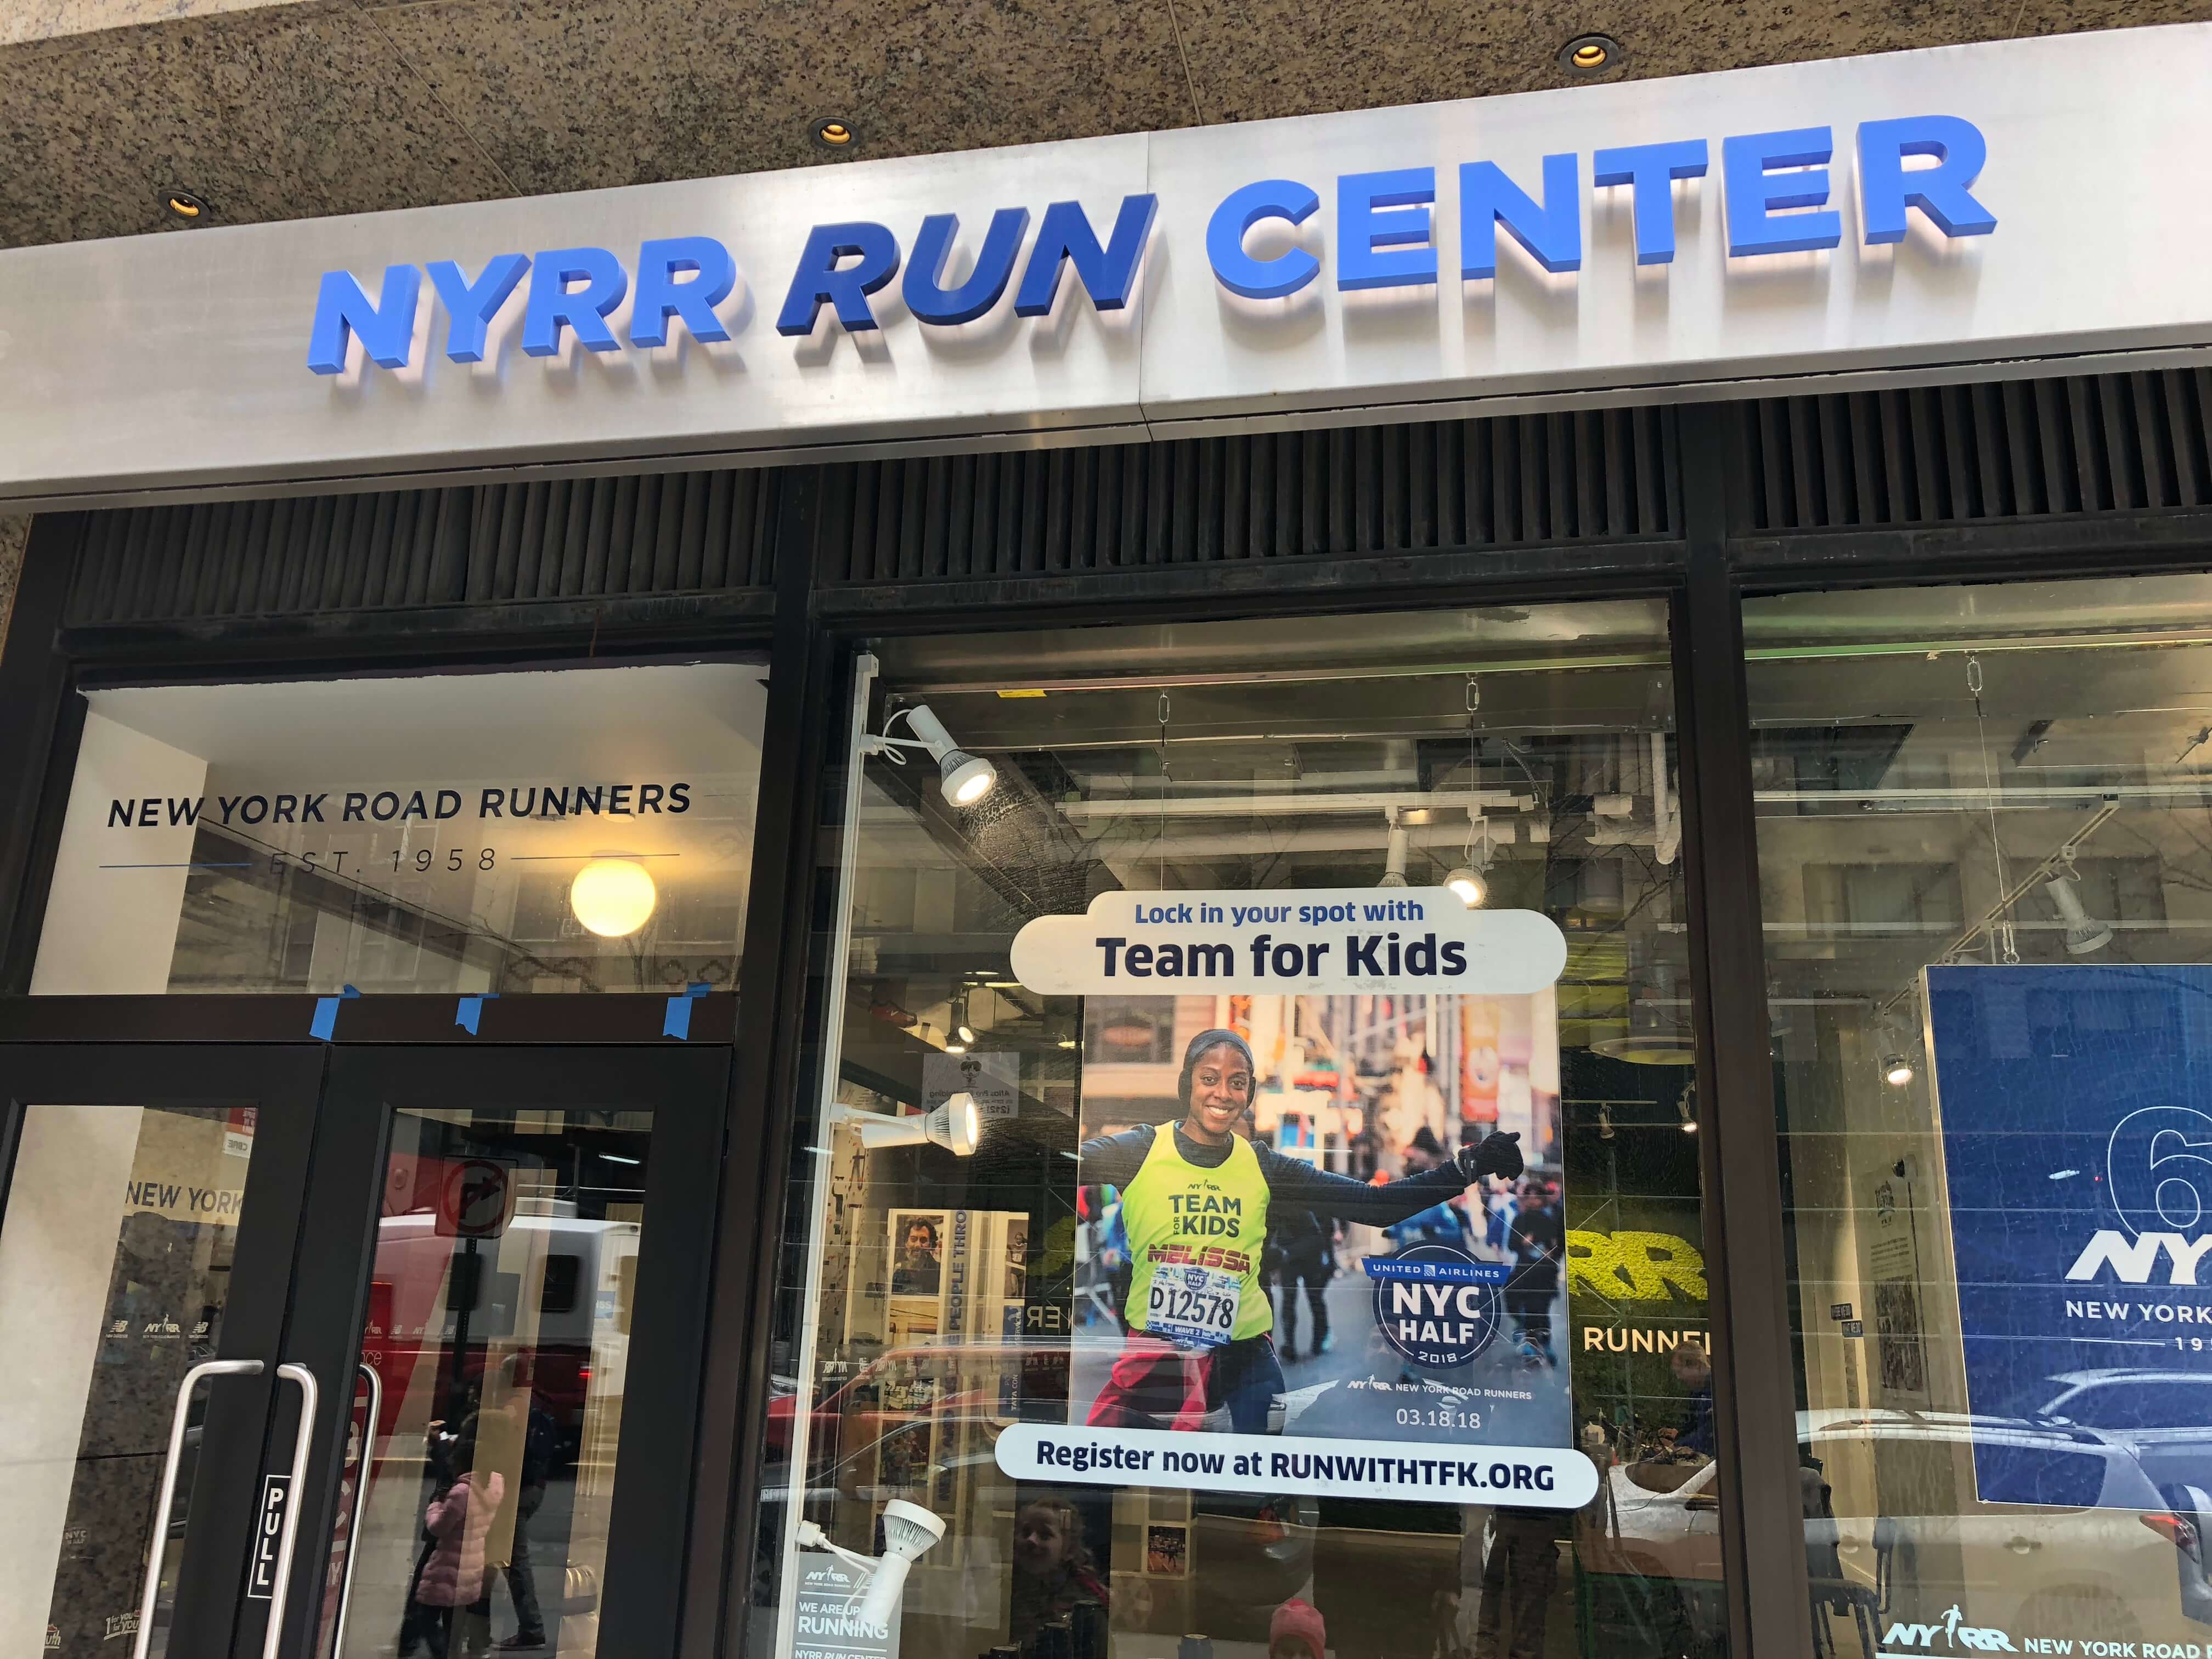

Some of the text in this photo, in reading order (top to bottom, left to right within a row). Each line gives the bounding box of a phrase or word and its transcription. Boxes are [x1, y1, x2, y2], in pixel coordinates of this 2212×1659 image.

[307, 115, 1997, 375] NYRR RUN CENTER
[108, 783, 692, 827] NEW YORK ROAD RUNNERS
[271, 848, 496, 874] EST. 1958
[1136, 900, 1423, 927] Lock in your spot with
[1096, 933, 1467, 978] Team for Kids
[125, 1181, 242, 1214] NEW YORK
[1169, 1194, 1241, 1216] TEAM
[1183, 1215, 1240, 1238] KIDS
[1148, 1244, 1250, 1274] MELISSA
[1373, 1263, 1499, 1278] UNITED AIRLINES
[950, 1262, 964, 1331] PEOPLE
[1392, 1282, 1481, 1319] NYC
[2067, 1300, 2212, 1324] NEW YORK
[1175, 1326, 1194, 1335] WAVE
[1400, 1319, 1475, 1344] HALF
[2175, 1337, 2212, 1351] 19
[1418, 1351, 1457, 1363] 2018
[1347, 1381, 1532, 1400] NYRR NEW YORK ROAD RUNNERS
[1396, 1408, 1481, 1429] 03.18.18
[1037, 1441, 1554, 1492] Register now at RUNWITHTFK.ORG
[256, 1487, 284, 1585] PULL
[805, 1571, 851, 1583] NYRR
[799, 1601, 860, 1616] WE ARE UP
[798, 1615, 888, 1639] RUNNING
[1882, 1622, 2021, 1653] NYRR
[2024, 1638, 2073, 1655] NEW
[2080, 1640, 2137, 1657] YORK
[2142, 1643, 2200, 1659] ROAD
[795, 1650, 823, 1659] NYRR
